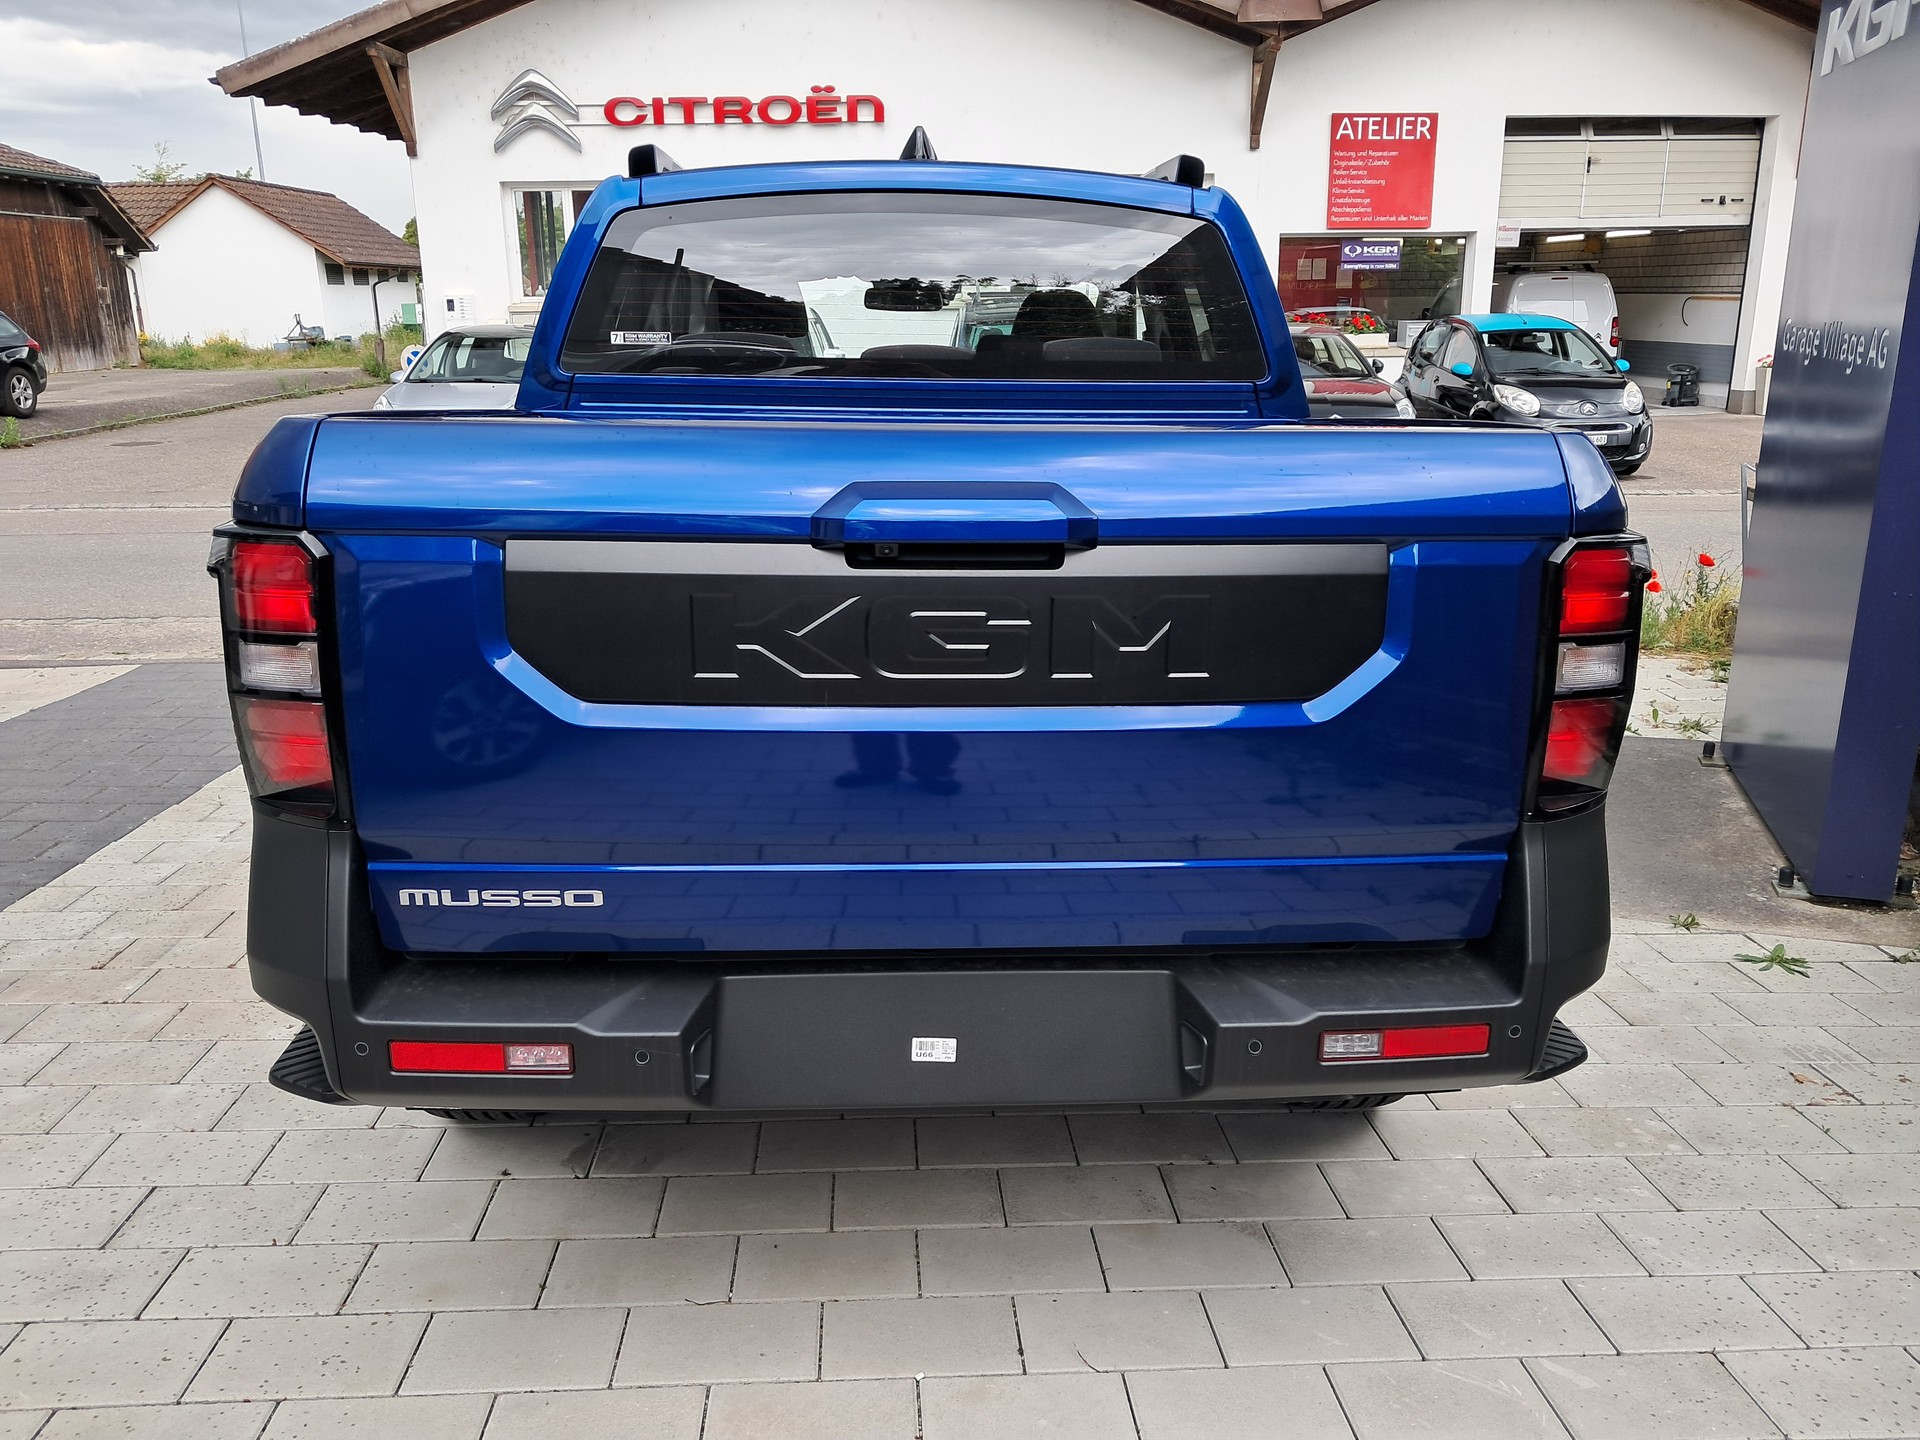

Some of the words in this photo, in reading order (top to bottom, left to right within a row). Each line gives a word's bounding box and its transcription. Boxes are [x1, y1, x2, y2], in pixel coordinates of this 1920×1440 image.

[1821, 0, 1920, 76] KG
[1336, 116, 1431, 140] ATELIER
[1333, 150, 1356, 158] Wartung
[1331, 196, 1371, 204] Ersatzfahrzeuge
[1330, 215, 1361, 223] Reparaturen
[1363, 245, 1398, 254] KGM
[1783, 318, 1820, 365] Garage
[1823, 320, 1865, 374] Village
[1866, 326, 1890, 369] AG
[690, 594, 1210, 679] KGM
[399, 889, 604, 906] MUSSO
